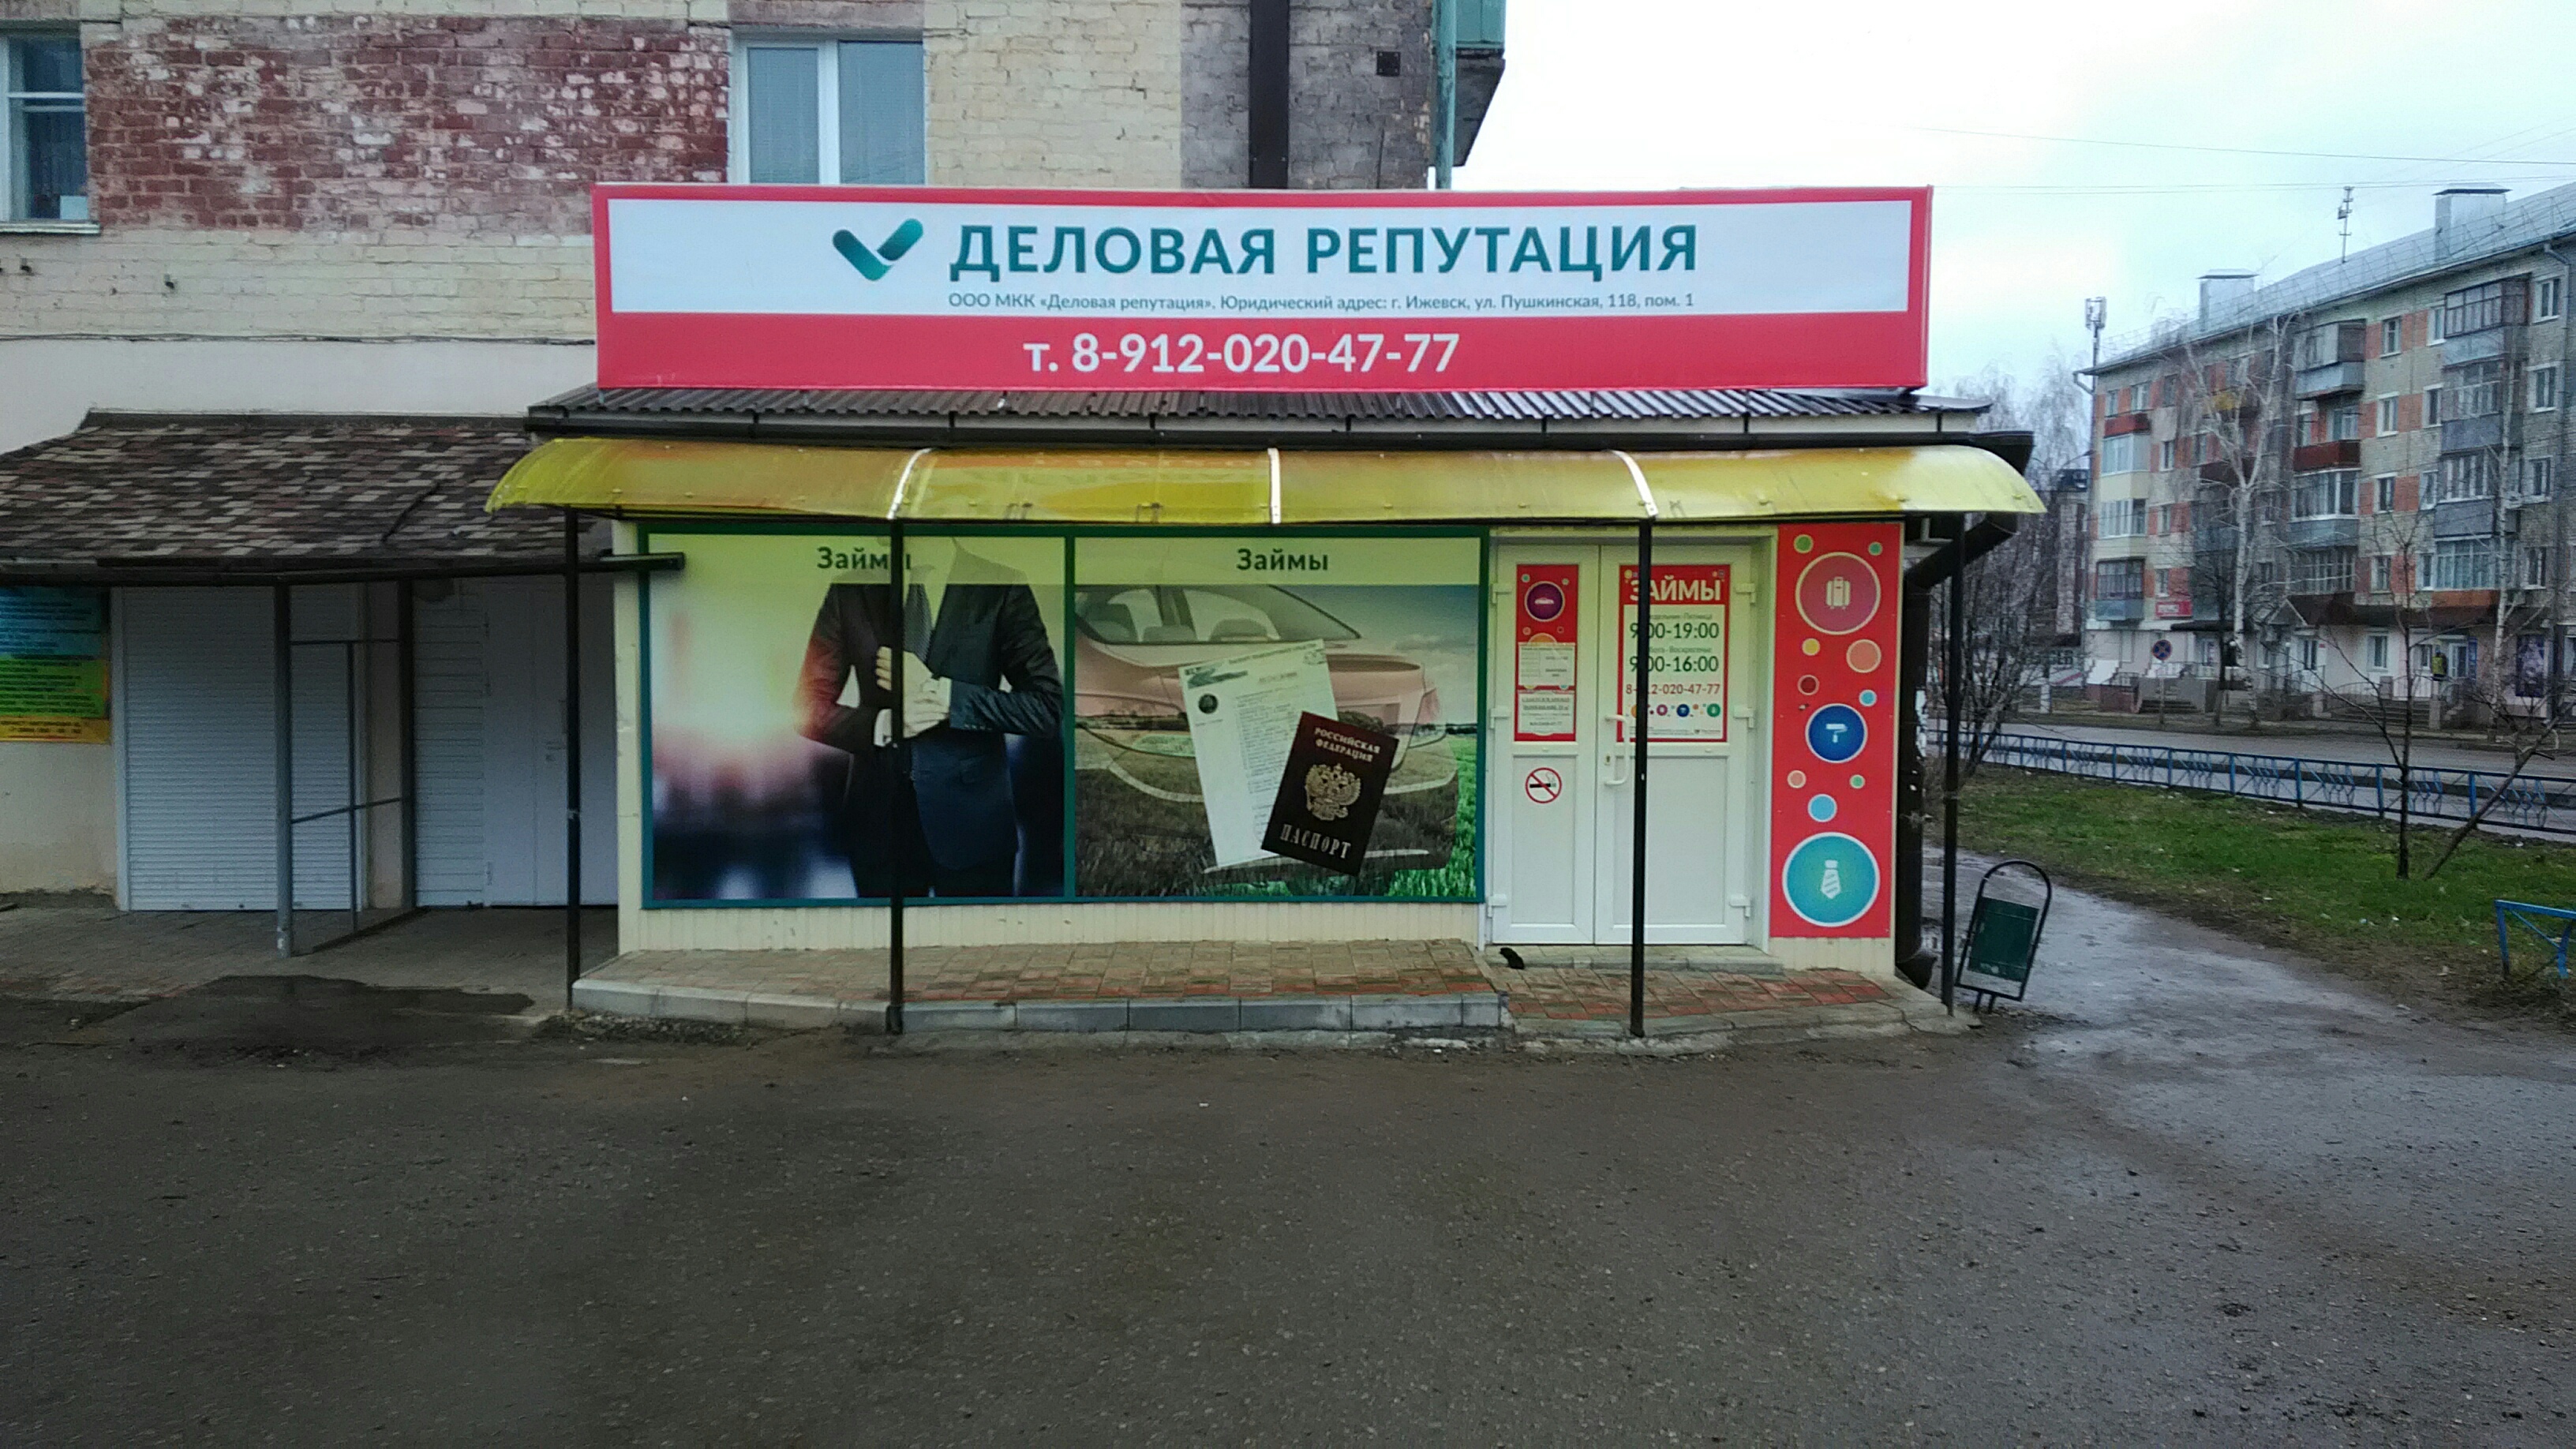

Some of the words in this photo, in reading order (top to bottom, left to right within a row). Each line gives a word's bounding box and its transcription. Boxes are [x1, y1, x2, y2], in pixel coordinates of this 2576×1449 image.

[949, 225, 1275, 283] ДЕЛОВАЯ
[1307, 224, 1696, 282] РЕПУТАЦИЯ
[949, 293, 990, 307] ООО
[995, 294, 1035, 307] МКК
[1040, 294, 1116, 309] «Деловая
[1220, 295, 1333, 311] Юридический
[1337, 295, 1387, 312] адрес:
[1391, 298, 1402, 309] г.
[1406, 296, 1470, 310] Ижевск,
[1474, 298, 1497, 311] ул.
[1501, 295, 1604, 311] Пушкинская,
[1608, 294, 1641, 309] 118,
[1644, 297, 1680, 307] пом.
[1686, 294, 1694, 306] 1
[1023, 343, 1058, 372] т.
[1072, 332, 1459, 373] 8-912-020-47-77
[1236, 548, 1328, 571] Займы
[1315, 728, 1380, 754] РОССИЙСКАЯ
[1316, 739, 1373, 762] ФЕДЕРАЦИЯ
[1280, 823, 1351, 859] ПАСПОРТ
